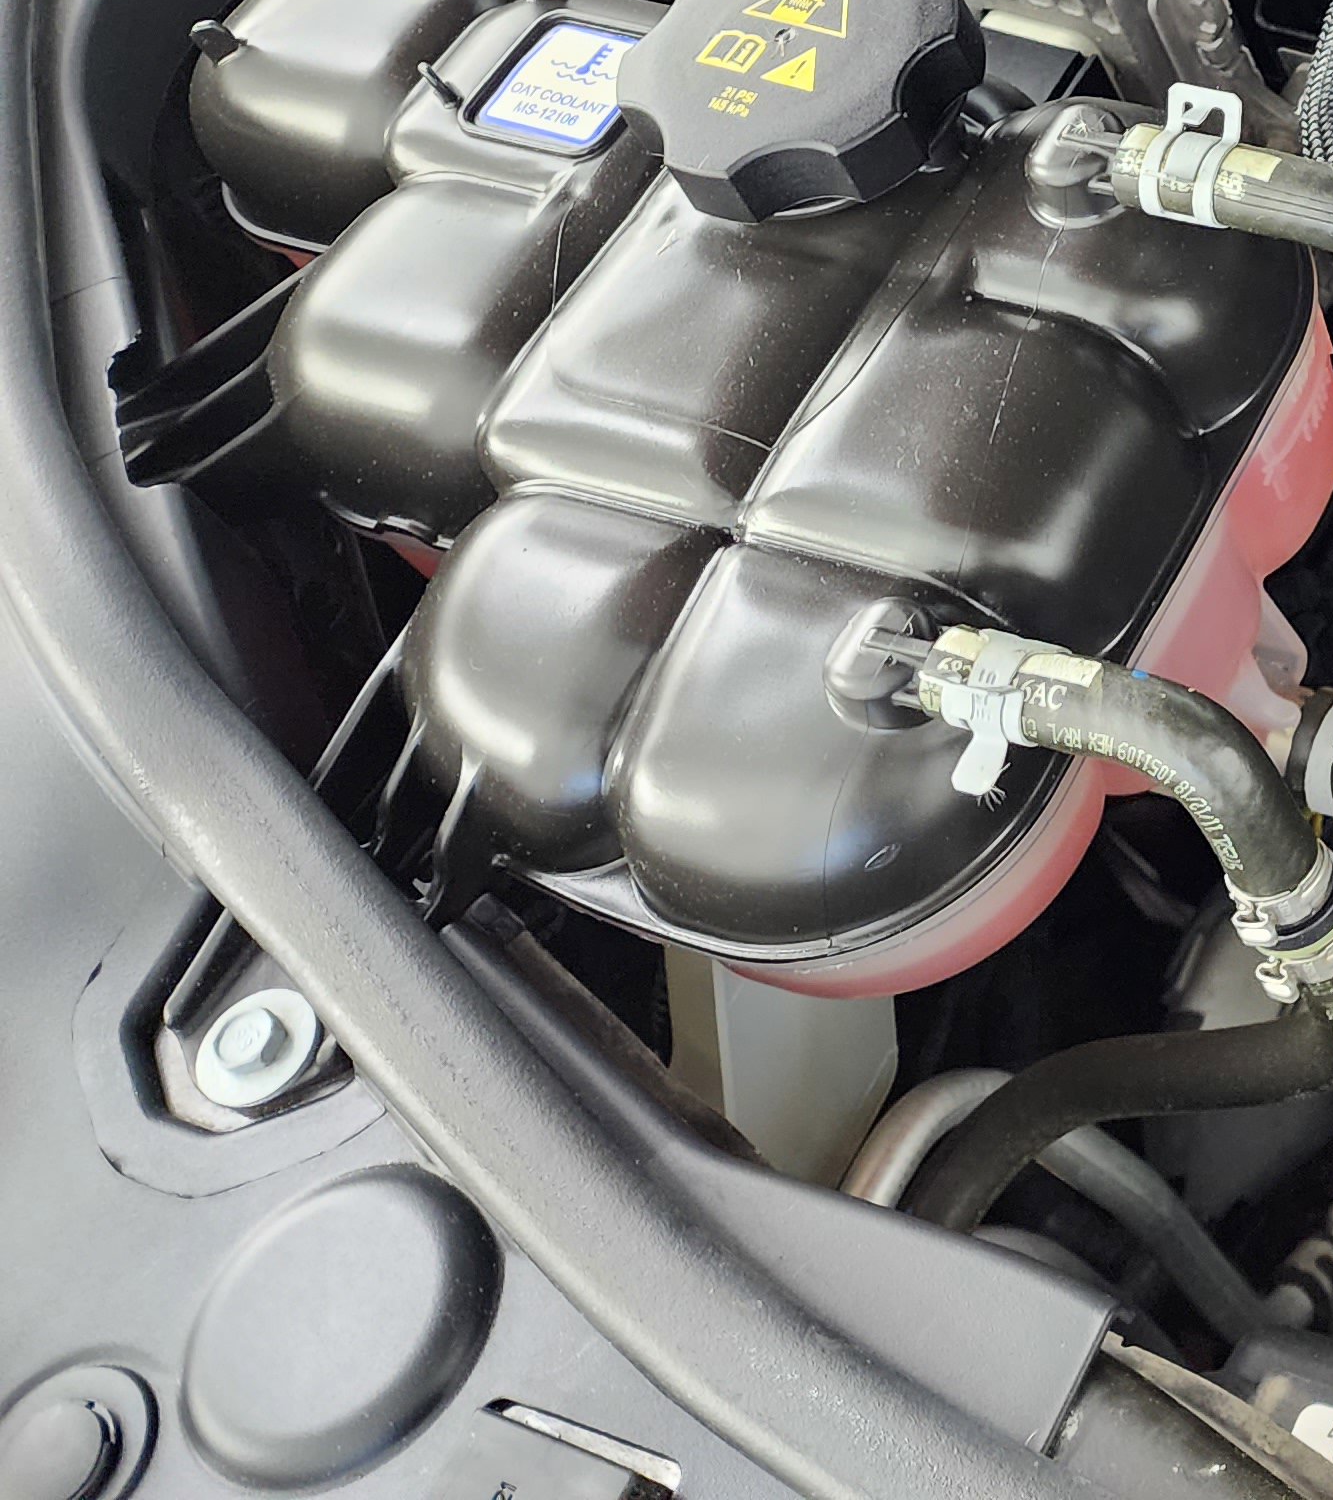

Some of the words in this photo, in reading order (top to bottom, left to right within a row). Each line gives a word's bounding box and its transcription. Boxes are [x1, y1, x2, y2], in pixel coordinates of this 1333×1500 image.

[510, 81, 542, 98] OAT
[540, 88, 610, 115] COOLANT
[720, 85, 738, 99] 21
[733, 89, 759, 105] PSI
[512, 100, 581, 126] MS-12106
[1116, 741, 1178, 786] 1051109
